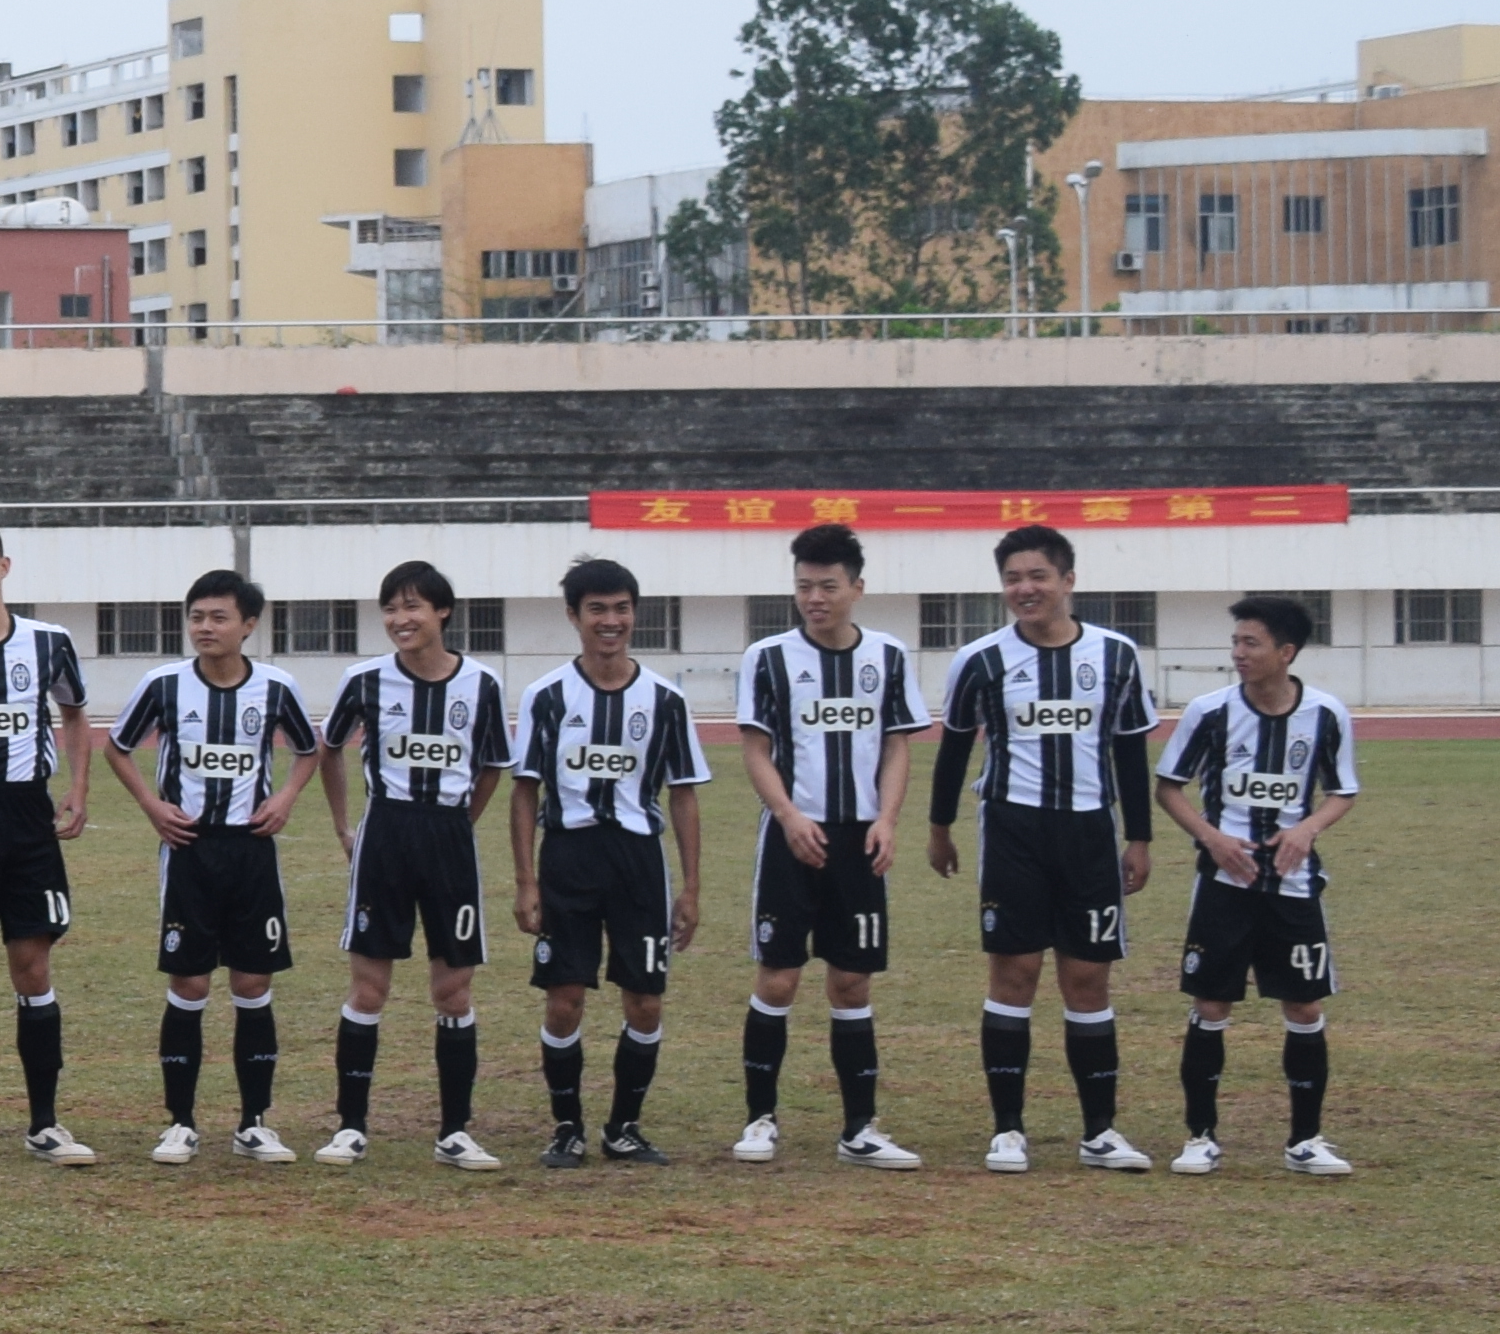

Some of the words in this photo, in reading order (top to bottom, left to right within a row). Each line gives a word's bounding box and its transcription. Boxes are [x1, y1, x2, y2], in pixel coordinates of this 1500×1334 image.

[801, 700, 874, 730] Jeep
[1016, 701, 1092, 731] Jeep
[184, 744, 254, 777] Jeep
[388, 734, 462, 768] Jeep
[566, 745, 637, 778] Jeep
[1228, 772, 1298, 806] Jeep
[266, 916, 281, 953] 9
[455, 904, 475, 942] 0
[855, 912, 880, 949] 11
[1087, 905, 1118, 944] 12
[643, 936, 669, 973] 13
[1290, 942, 1327, 981] 47
